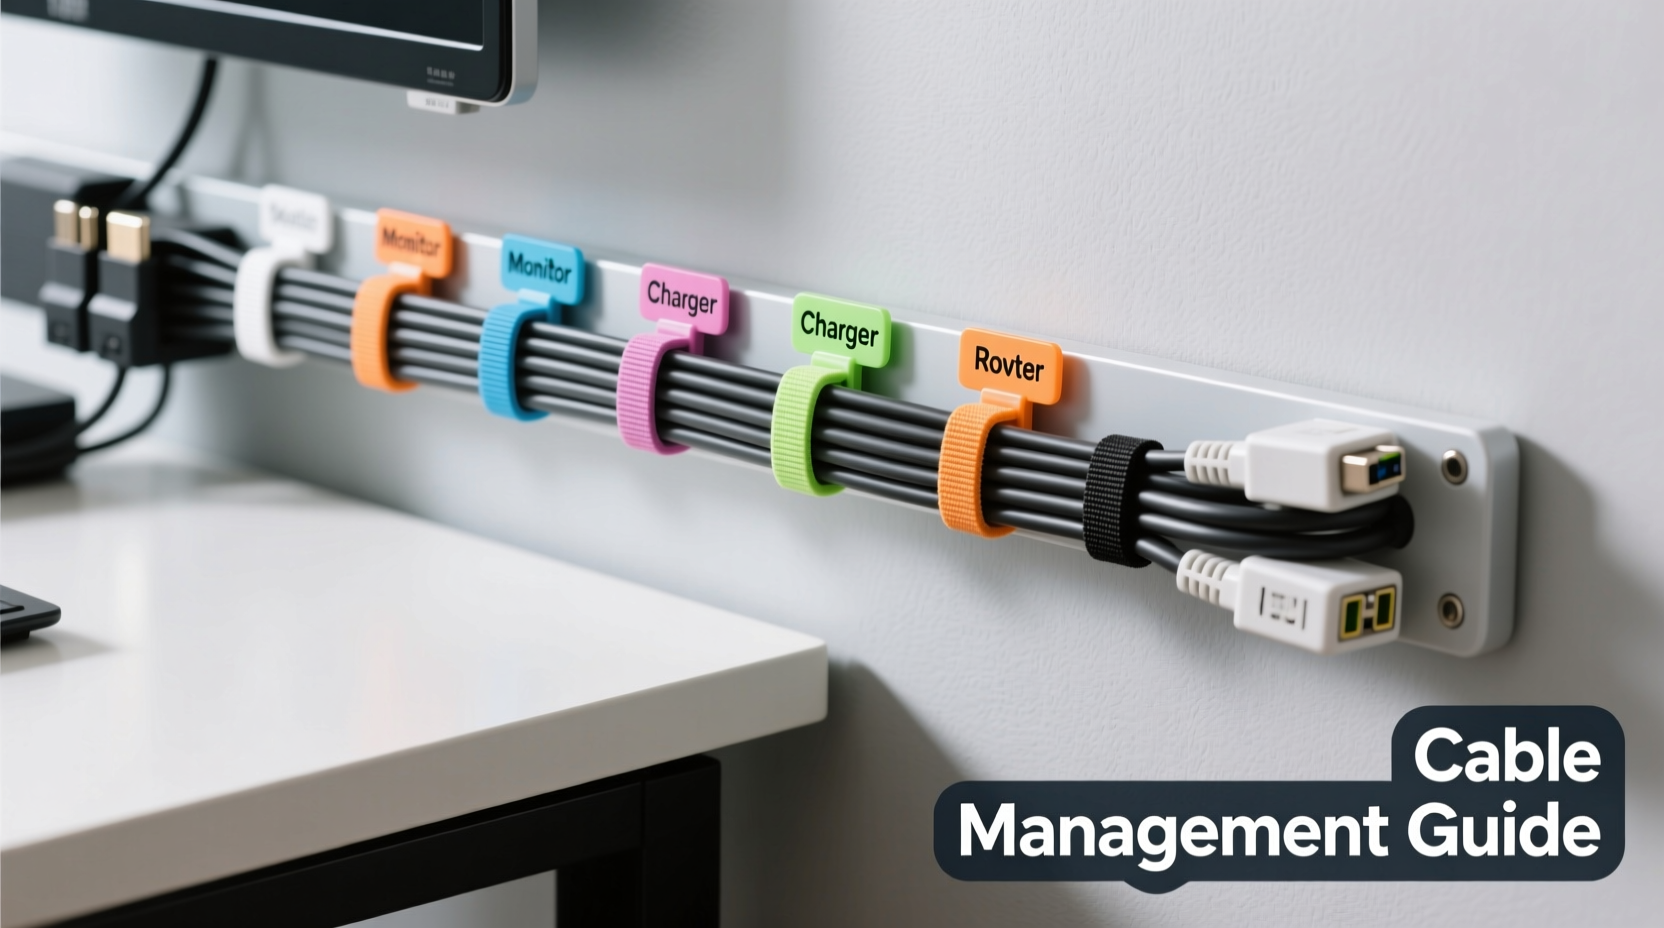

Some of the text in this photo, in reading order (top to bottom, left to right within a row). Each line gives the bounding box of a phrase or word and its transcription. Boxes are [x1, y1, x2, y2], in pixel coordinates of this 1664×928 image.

[508, 250, 572, 285] Monitor
[647, 280, 718, 317] Charger
[800, 310, 879, 350] Charger
